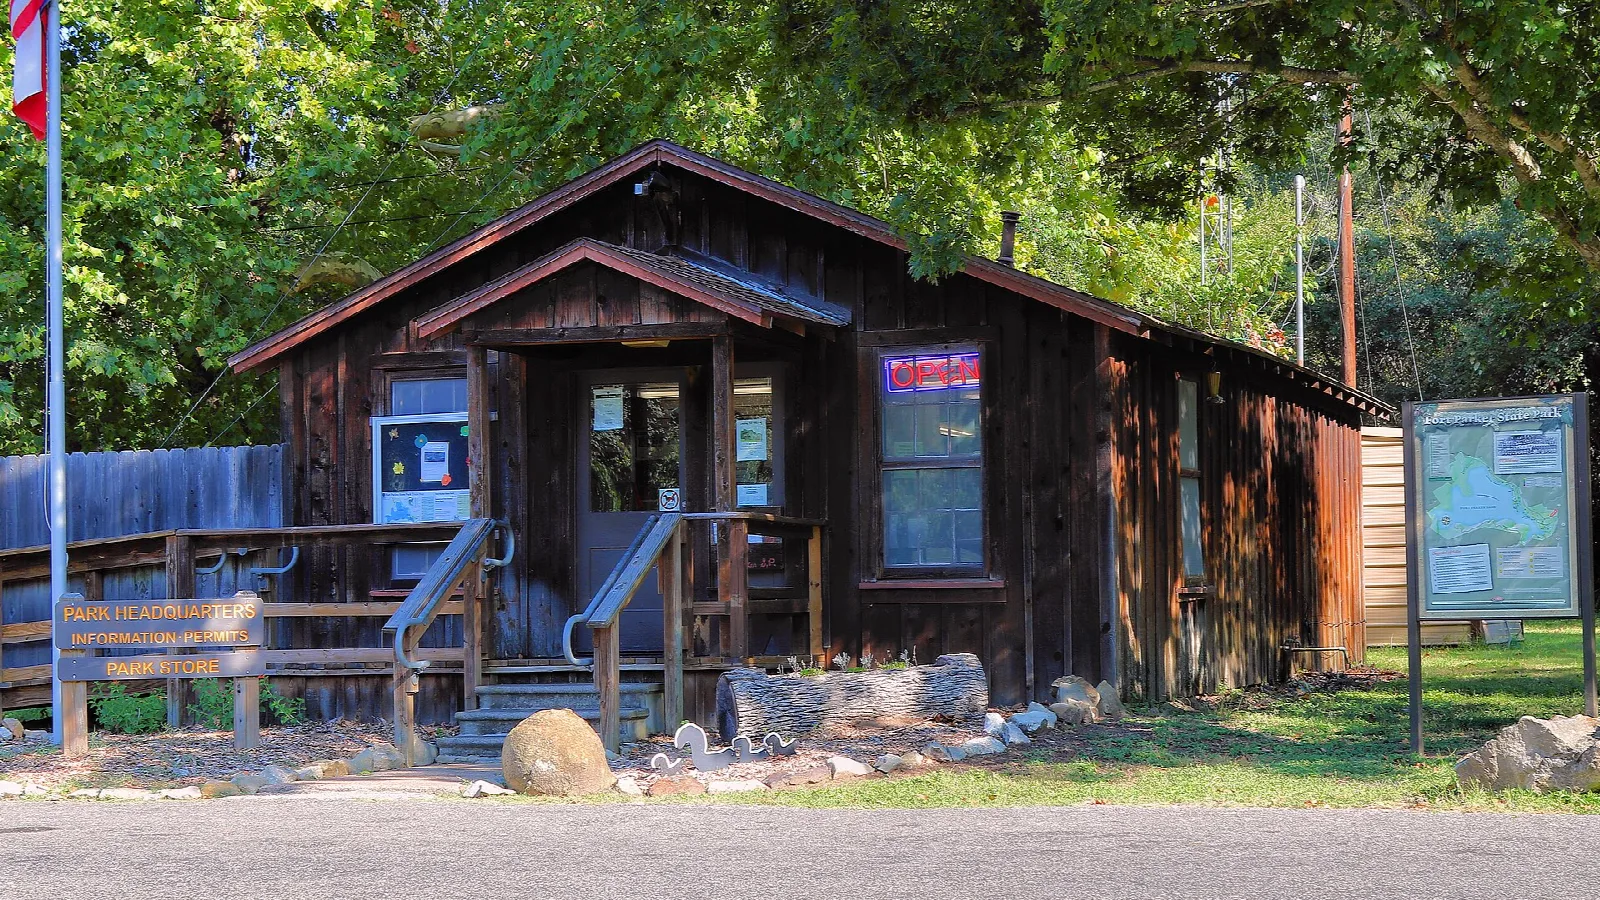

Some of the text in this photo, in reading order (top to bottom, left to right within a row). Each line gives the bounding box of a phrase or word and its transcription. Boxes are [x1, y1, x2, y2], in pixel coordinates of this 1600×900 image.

[892, 358, 980, 387] OPEN
[1497, 411, 1530, 422] State
[1532, 407, 1562, 419] Park
[63, 603, 256, 622] PARK HEADQUARTERS
[71, 630, 249, 645] INFORMATION PERMITS
[107, 659, 220, 676] PARK STORE
